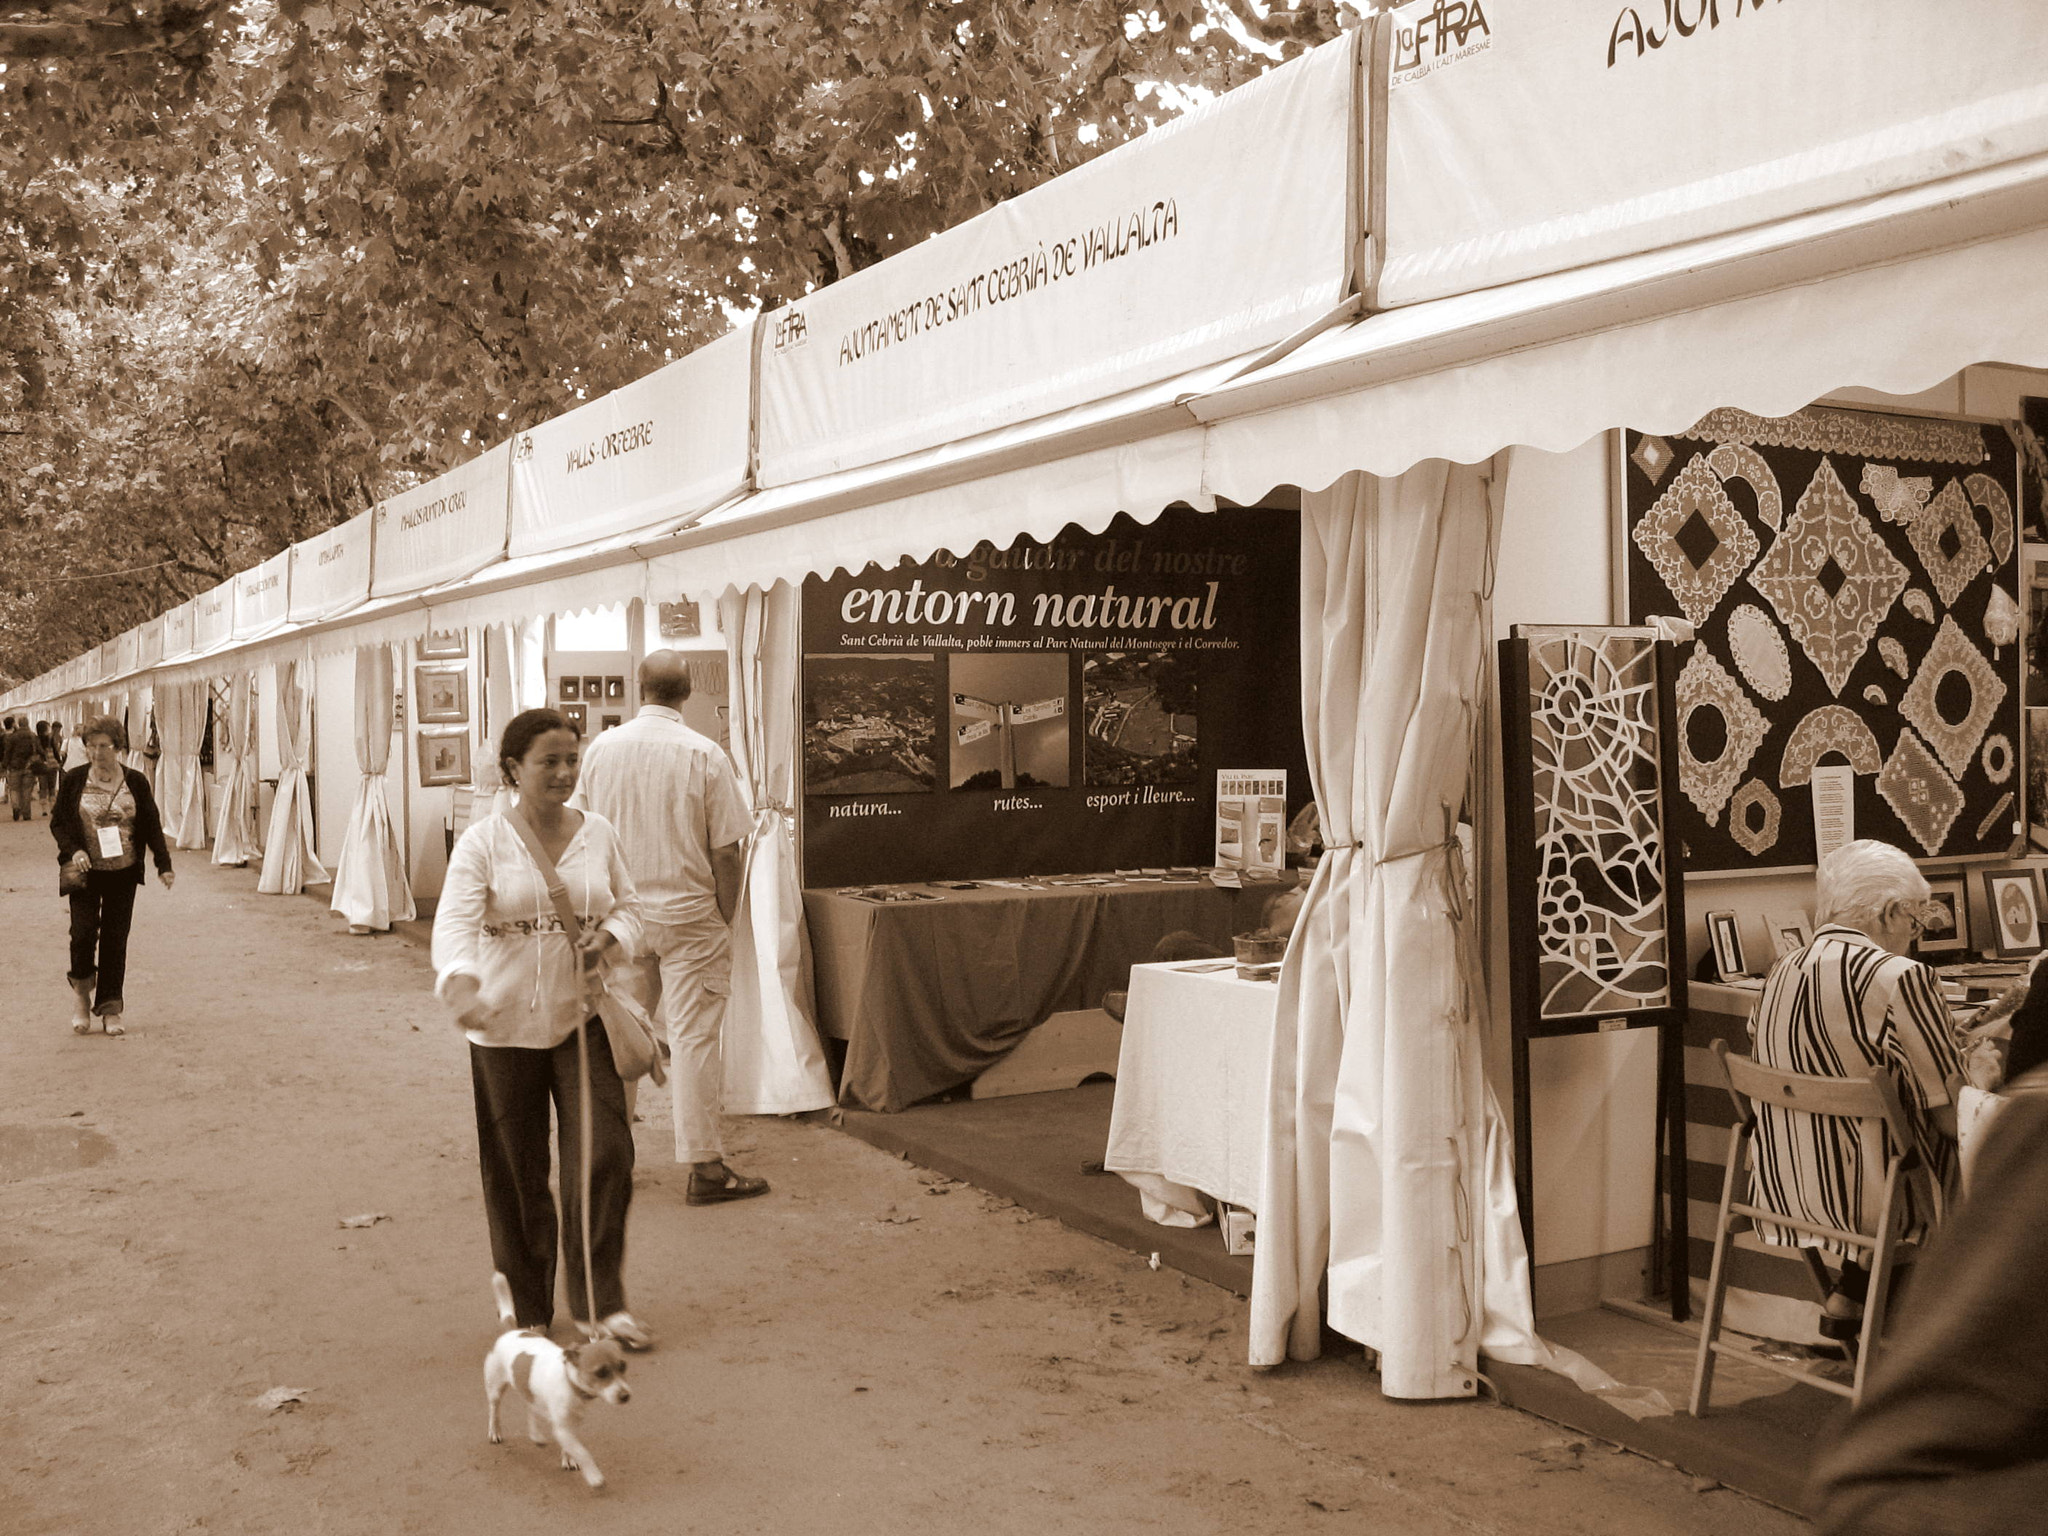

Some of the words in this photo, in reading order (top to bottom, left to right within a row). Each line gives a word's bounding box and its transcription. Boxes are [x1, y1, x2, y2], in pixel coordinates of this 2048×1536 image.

[1454, 38, 1491, 62] MARESME
[839, 301, 922, 367] AJUNTAMENT
[924, 293, 944, 331] DE
[946, 274, 985, 322] SANT
[987, 240, 1048, 305] CEBRIÀ
[1052, 238, 1077, 281] DE
[1081, 197, 1178, 272] VALLALTA
[566, 441, 595, 474] VALLS
[601, 420, 653, 460] ORFEBRE
[841, 579, 1017, 625] entorn
[1032, 581, 1219, 630] natural
[840, 633, 866, 647] Sant
[868, 633, 904, 647] Cebrià
[906, 633, 920, 647] de
[922, 634, 964, 650] Vallalta,
[966, 635, 993, 652] poble
[995, 637, 1031, 650] immers
[1033, 636, 1044, 649] al
[1046, 637, 1069, 650] Parc
[1069, 637, 1109, 650] Natural
[1110, 637, 1124, 650] del
[1124, 638, 1177, 654] Montnegre
[1184, 637, 1193, 650] el
[1194, 637, 1241, 650] Corredor.
[829, 801, 903, 819] natura...
[993, 795, 1044, 812] rutes...
[1086, 792, 1131, 813] esport
[1133, 787, 1140, 805] i
[1142, 785, 1196, 806] lleure...
